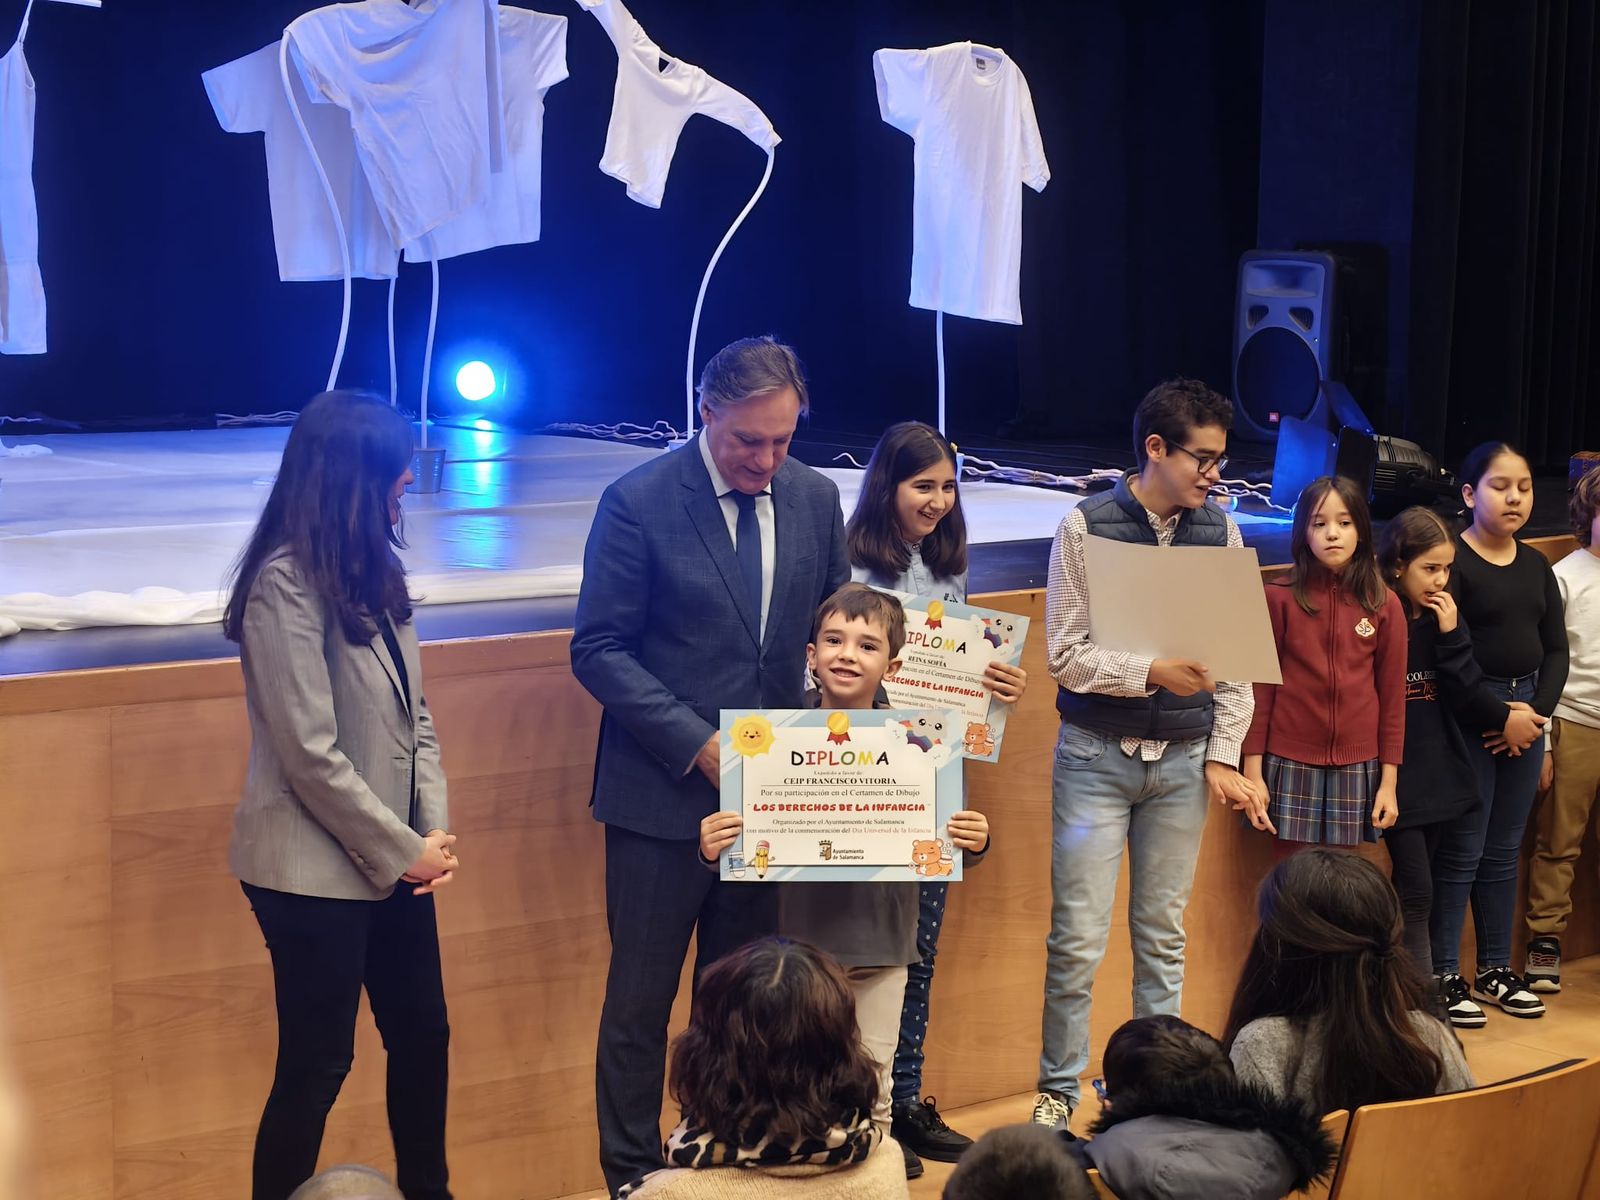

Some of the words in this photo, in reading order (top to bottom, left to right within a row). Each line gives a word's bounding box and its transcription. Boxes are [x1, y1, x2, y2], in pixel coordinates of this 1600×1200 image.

[906, 631, 966, 654] IPLOMA
[908, 655, 926, 663] REINA
[927, 658, 947, 667] SOFÍA
[931, 669, 956, 680] Certamen
[891, 676, 920, 686] RECHOS
[921, 681, 933, 689] DE
[944, 685, 984, 698] INFANCIA
[791, 750, 889, 766] DIPLOMA
[784, 790, 830, 798] participación
[778, 804, 836, 812] DERECHOS
